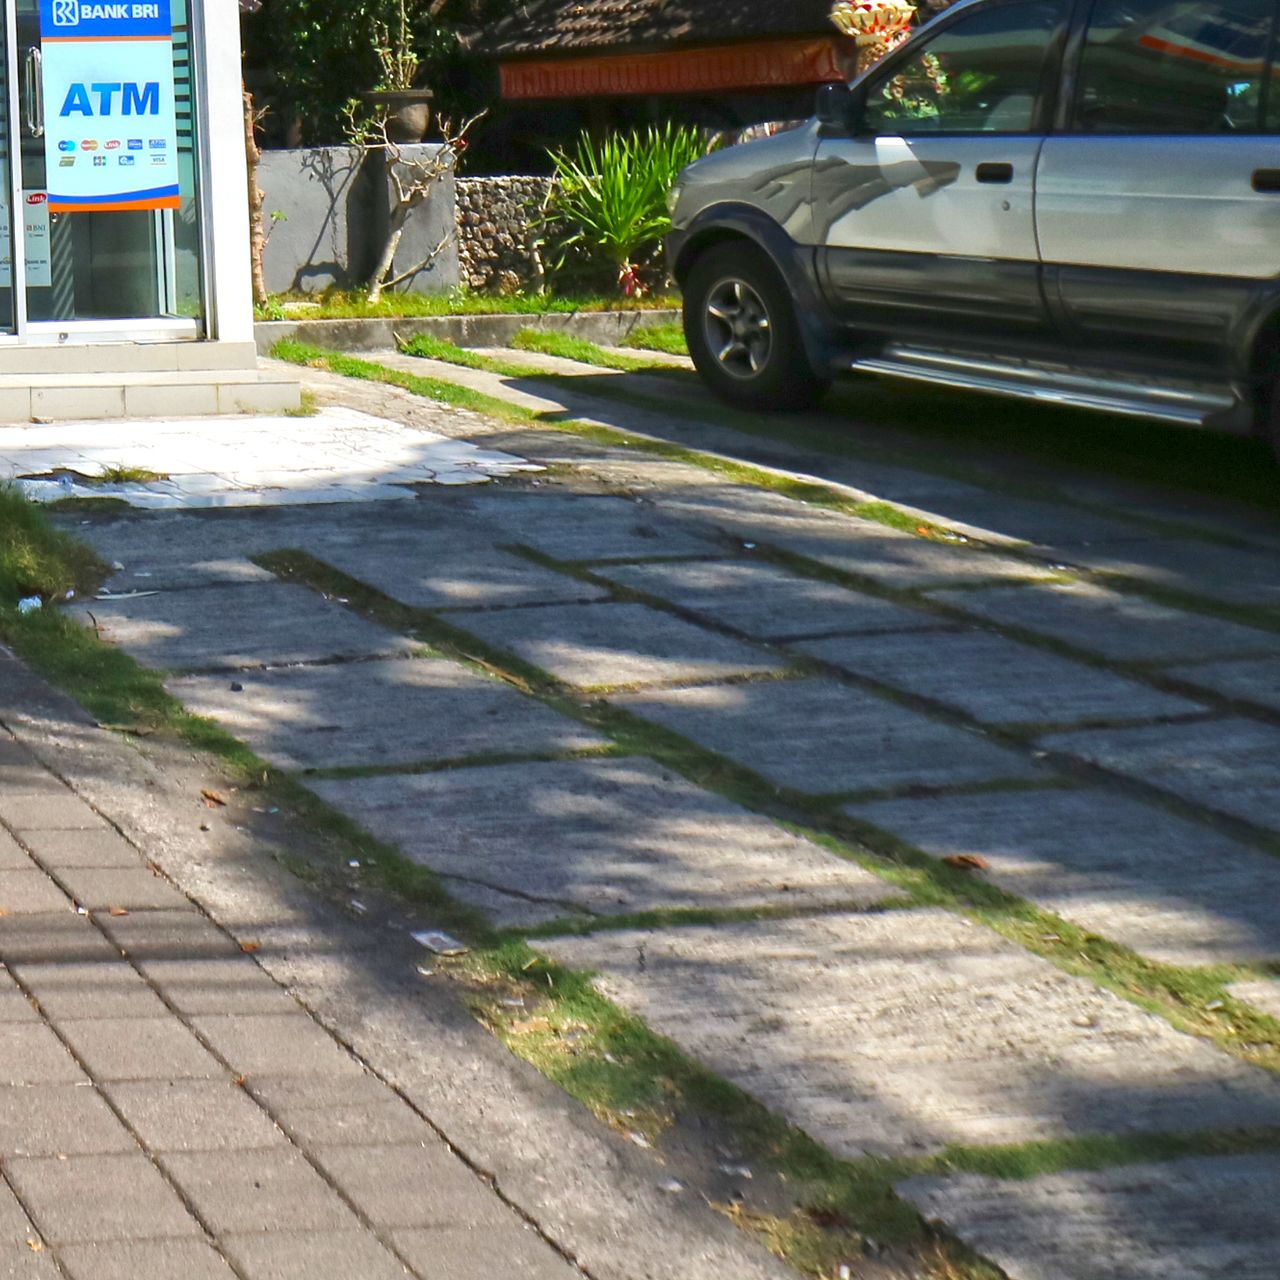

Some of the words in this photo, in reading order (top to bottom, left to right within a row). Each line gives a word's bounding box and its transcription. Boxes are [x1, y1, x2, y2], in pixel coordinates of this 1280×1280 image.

[80, 4, 129, 19] BANK
[131, 4, 159, 19] BRI
[59, 82, 160, 117] ATM
